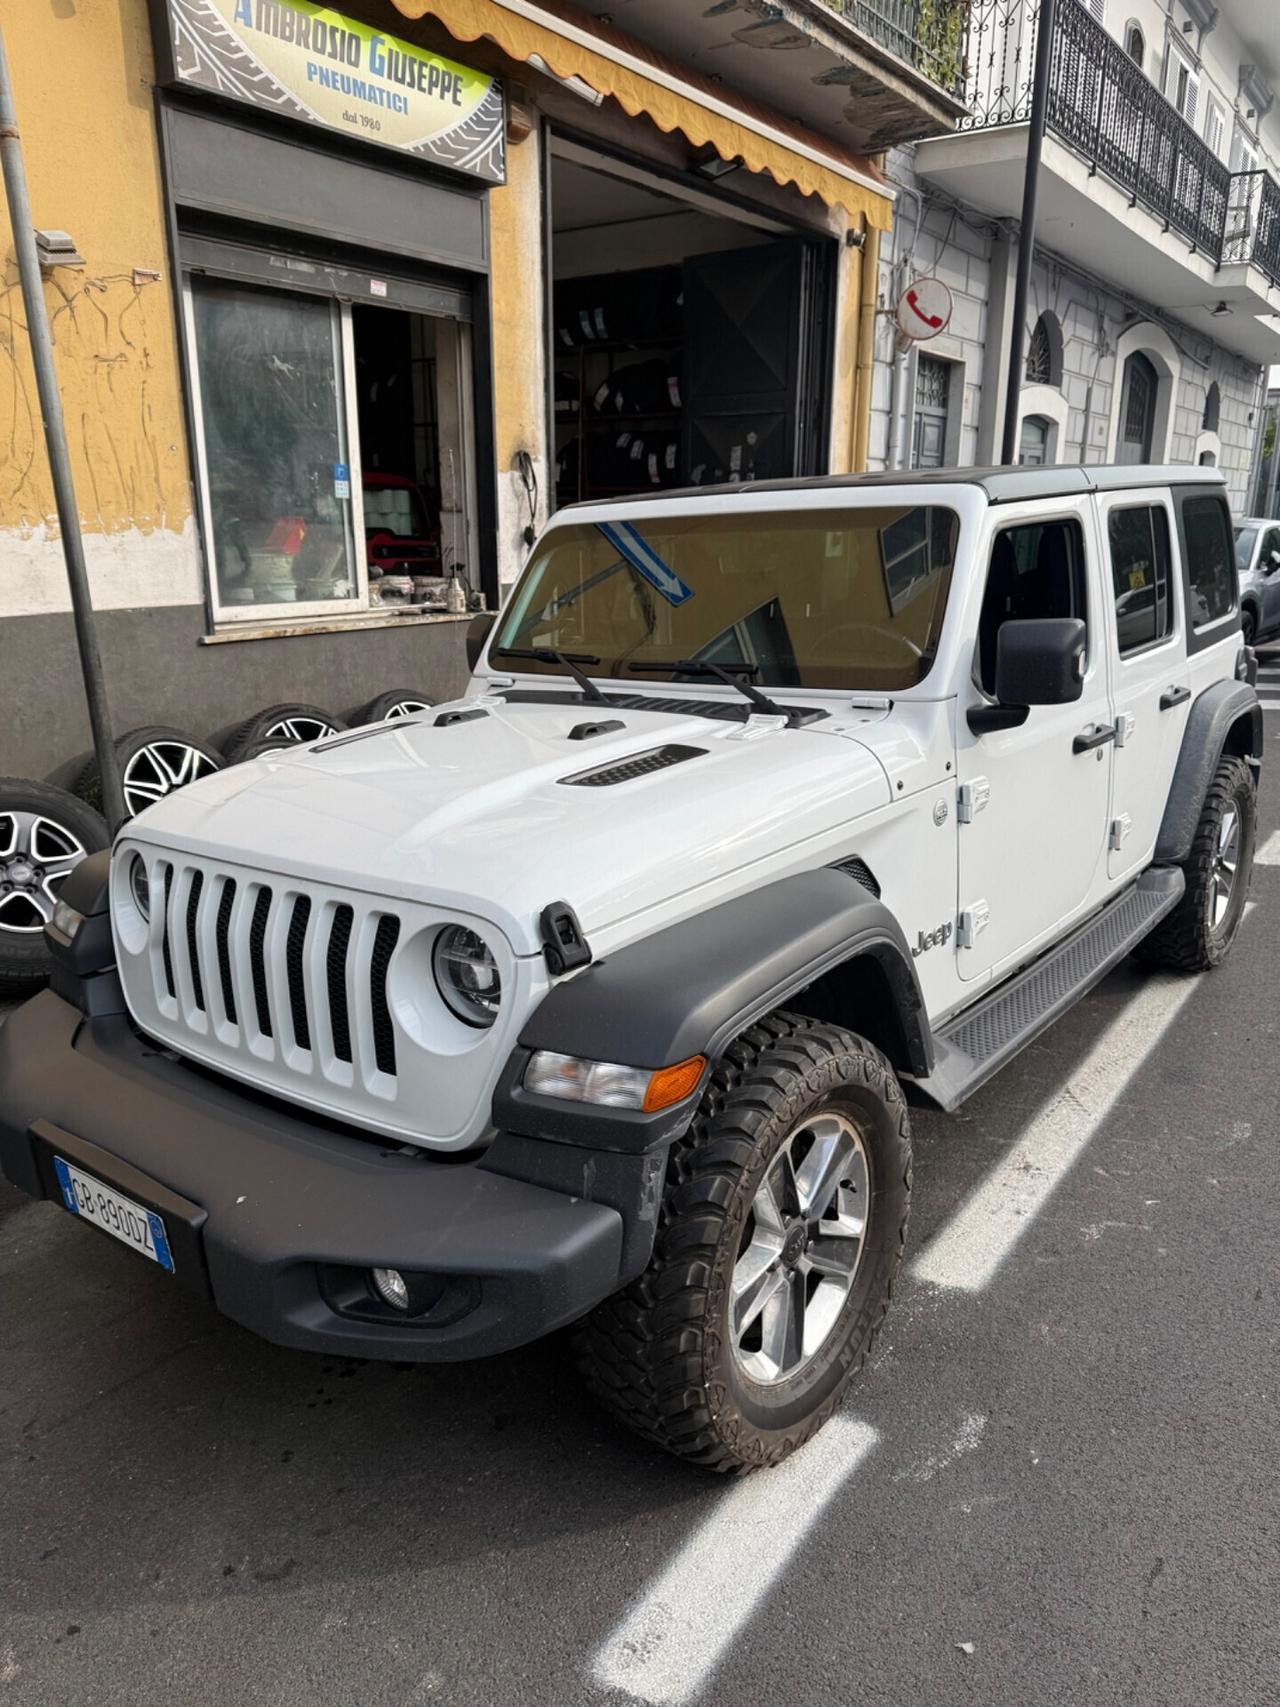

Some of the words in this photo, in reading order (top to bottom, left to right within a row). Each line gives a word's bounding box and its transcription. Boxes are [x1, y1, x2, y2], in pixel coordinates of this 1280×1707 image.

[234, 0, 361, 69] AMBROSIO
[369, 34, 464, 107] GIUSEPPE
[306, 61, 408, 116] PNEUMATICI
[342, 109, 358, 124] dal
[359, 114, 382, 132] 1980
[911, 921, 953, 958] Jeep
